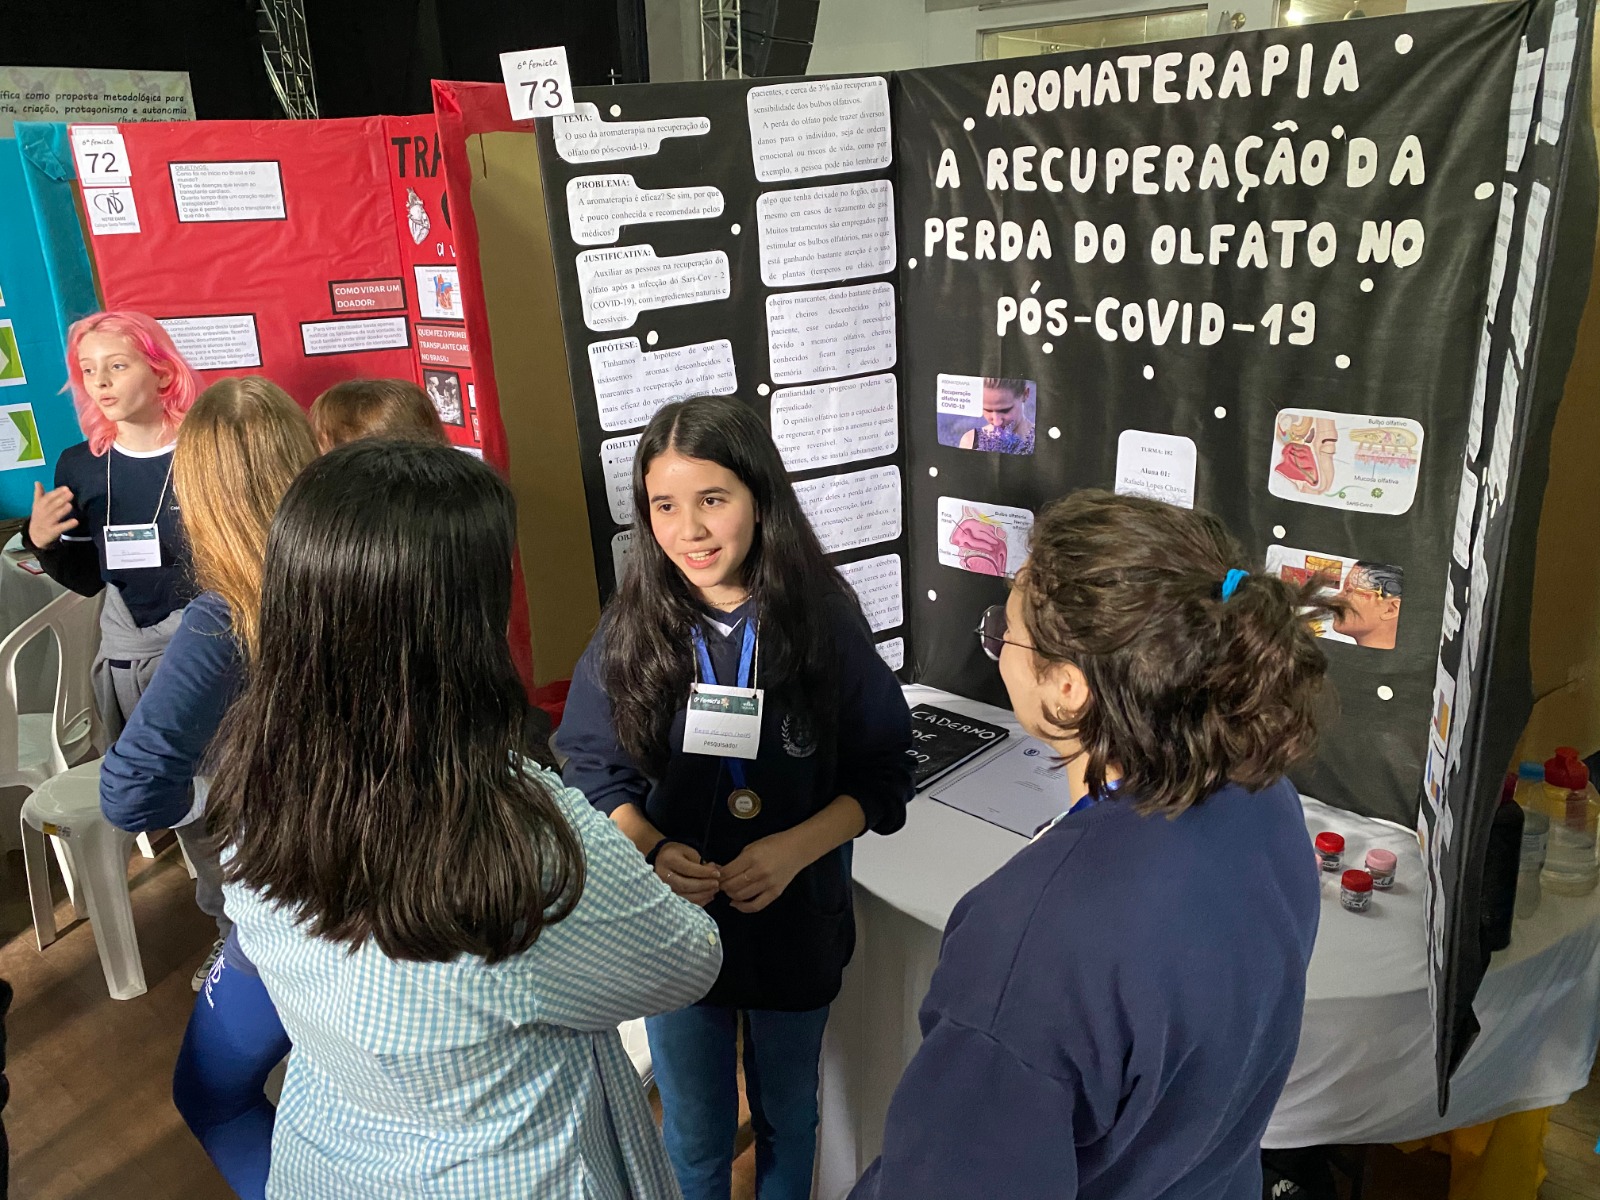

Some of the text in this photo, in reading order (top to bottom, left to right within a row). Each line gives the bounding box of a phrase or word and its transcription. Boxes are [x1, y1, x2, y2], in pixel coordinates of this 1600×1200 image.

[986, 40, 1358, 117] AROMATERAPIA
[520, 78, 562, 111] 73
[791, 86, 807, 94] cerca
[831, 82, 842, 90] não
[844, 81, 876, 90] recuperam
[56, 93, 98, 102] proposta
[104, 92, 161, 102] metodológica
[166, 95, 184, 103] para
[23, 105, 58, 114] criação,
[65, 106, 128, 115] protagonismo
[754, 103, 795, 114] sensibilidade
[797, 102, 808, 110] dos
[810, 100, 832, 108] bulbos
[562, 115, 593, 123] TEMA:
[763, 121, 768, 129] A
[771, 120, 788, 129] perda
[791, 118, 799, 126] do
[802, 116, 820, 125] olfato
[822, 115, 838, 124] pode
[839, 113, 858, 121] trazer
[589, 130, 597, 138] da
[600, 126, 645, 137] aromaterapia
[658, 123, 698, 132] recuperação
[700, 121, 708, 129] do
[568, 143, 649, 157] olfato no pós-covid-19.
[84, 152, 118, 173] 72
[936, 120, 1425, 202] A RECUPERAÇÃO DA
[577, 179, 630, 189] PROBLEMA:
[579, 198, 584, 206] A
[587, 195, 632, 205] aromaterapia
[641, 192, 664, 202] eficaz?
[677, 192, 692, 200] sim,
[693, 191, 705, 199] por
[707, 190, 719, 198] que
[587, 214, 609, 223] pouco
[612, 210, 646, 220] conhecida
[656, 207, 700, 216] recomendada
[703, 205, 720, 215] pelos
[582, 228, 614, 238] médicos?
[766, 227, 788, 235] Muitos
[790, 223, 827, 232] tratamentos
[842, 218, 876, 228] empregados
[878, 216, 888, 224] para
[924, 217, 1424, 268] PERDA DO OLFATO NO
[584, 250, 651, 263] JUSTIFICATIVA:
[594, 269, 622, 278] Auxiliar
[635, 265, 661, 275] pessoas
[674, 258, 713, 270] recuperação
[715, 256, 724, 264] do
[335, 287, 359, 295] COMO
[360, 285, 385, 293] VIRAR
[588, 285, 608, 294] olfato
[612, 283, 627, 293] após
[639, 278, 667, 289] infecção
[681, 274, 711, 283] Sars-Cov
[590, 297, 637, 310] (COVID-19),
[655, 291, 694, 303] ingredientes
[696, 288, 721, 296] naturais
[592, 315, 629, 325] acessíveis.
[997, 281, 1315, 346] PÓS-COVID-19
[418, 329, 433, 337] QUEM
[444, 330, 447, 338] O
[420, 341, 456, 350] TRANSPLANTE
[592, 341, 638, 354] HIPÓTESE:
[654, 350, 681, 361] hipótese
[703, 344, 715, 353] que
[598, 373, 633, 384] usássemos
[645, 367, 669, 376] aromas
[675, 358, 721, 371] desconhecidos
[600, 388, 633, 399] marcantes
[643, 380, 683, 392] recuperação
[685, 376, 694, 384] do
[696, 374, 715, 382] olfato
[1141, 467, 1158, 476] Aluna
[1354, 475, 1399, 485] Mucosa olfativa
[912, 711, 996, 740] CADERNO
